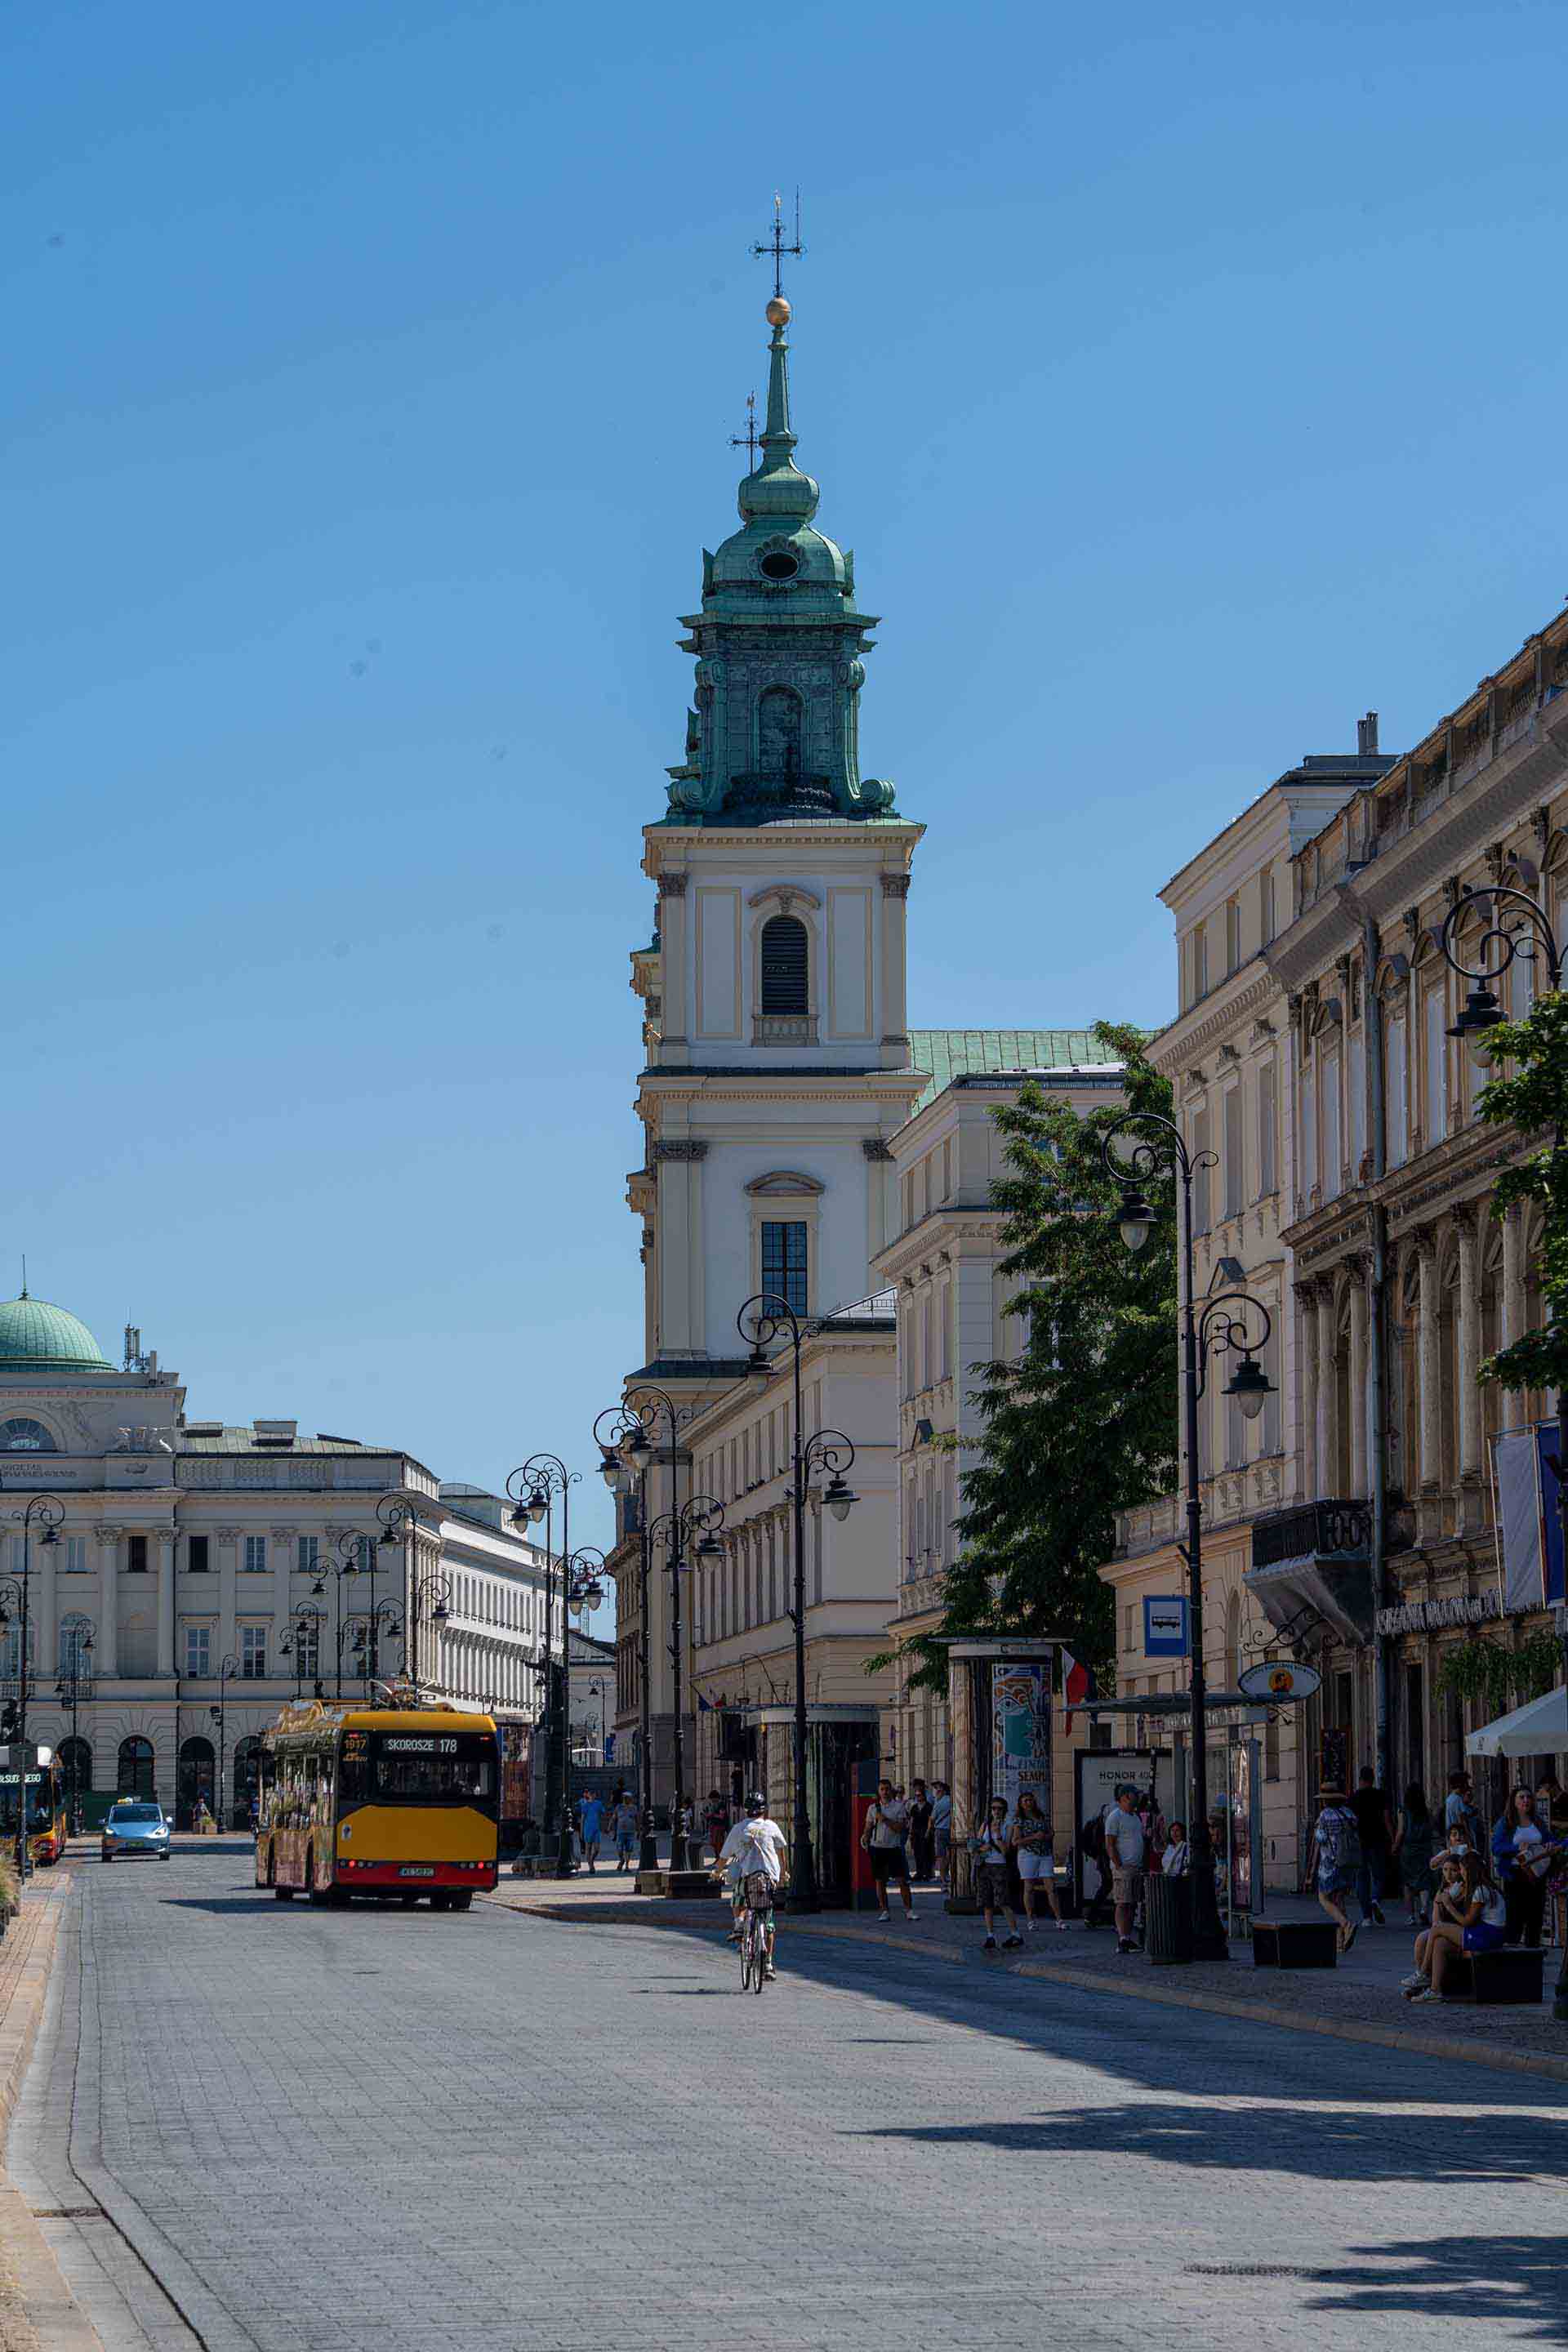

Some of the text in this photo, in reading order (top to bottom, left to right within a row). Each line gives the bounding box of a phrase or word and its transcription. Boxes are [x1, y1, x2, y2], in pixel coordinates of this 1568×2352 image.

[387, 1738, 457, 1753] SKOROSZE 178
[1098, 1771, 1136, 1780] HONOR
